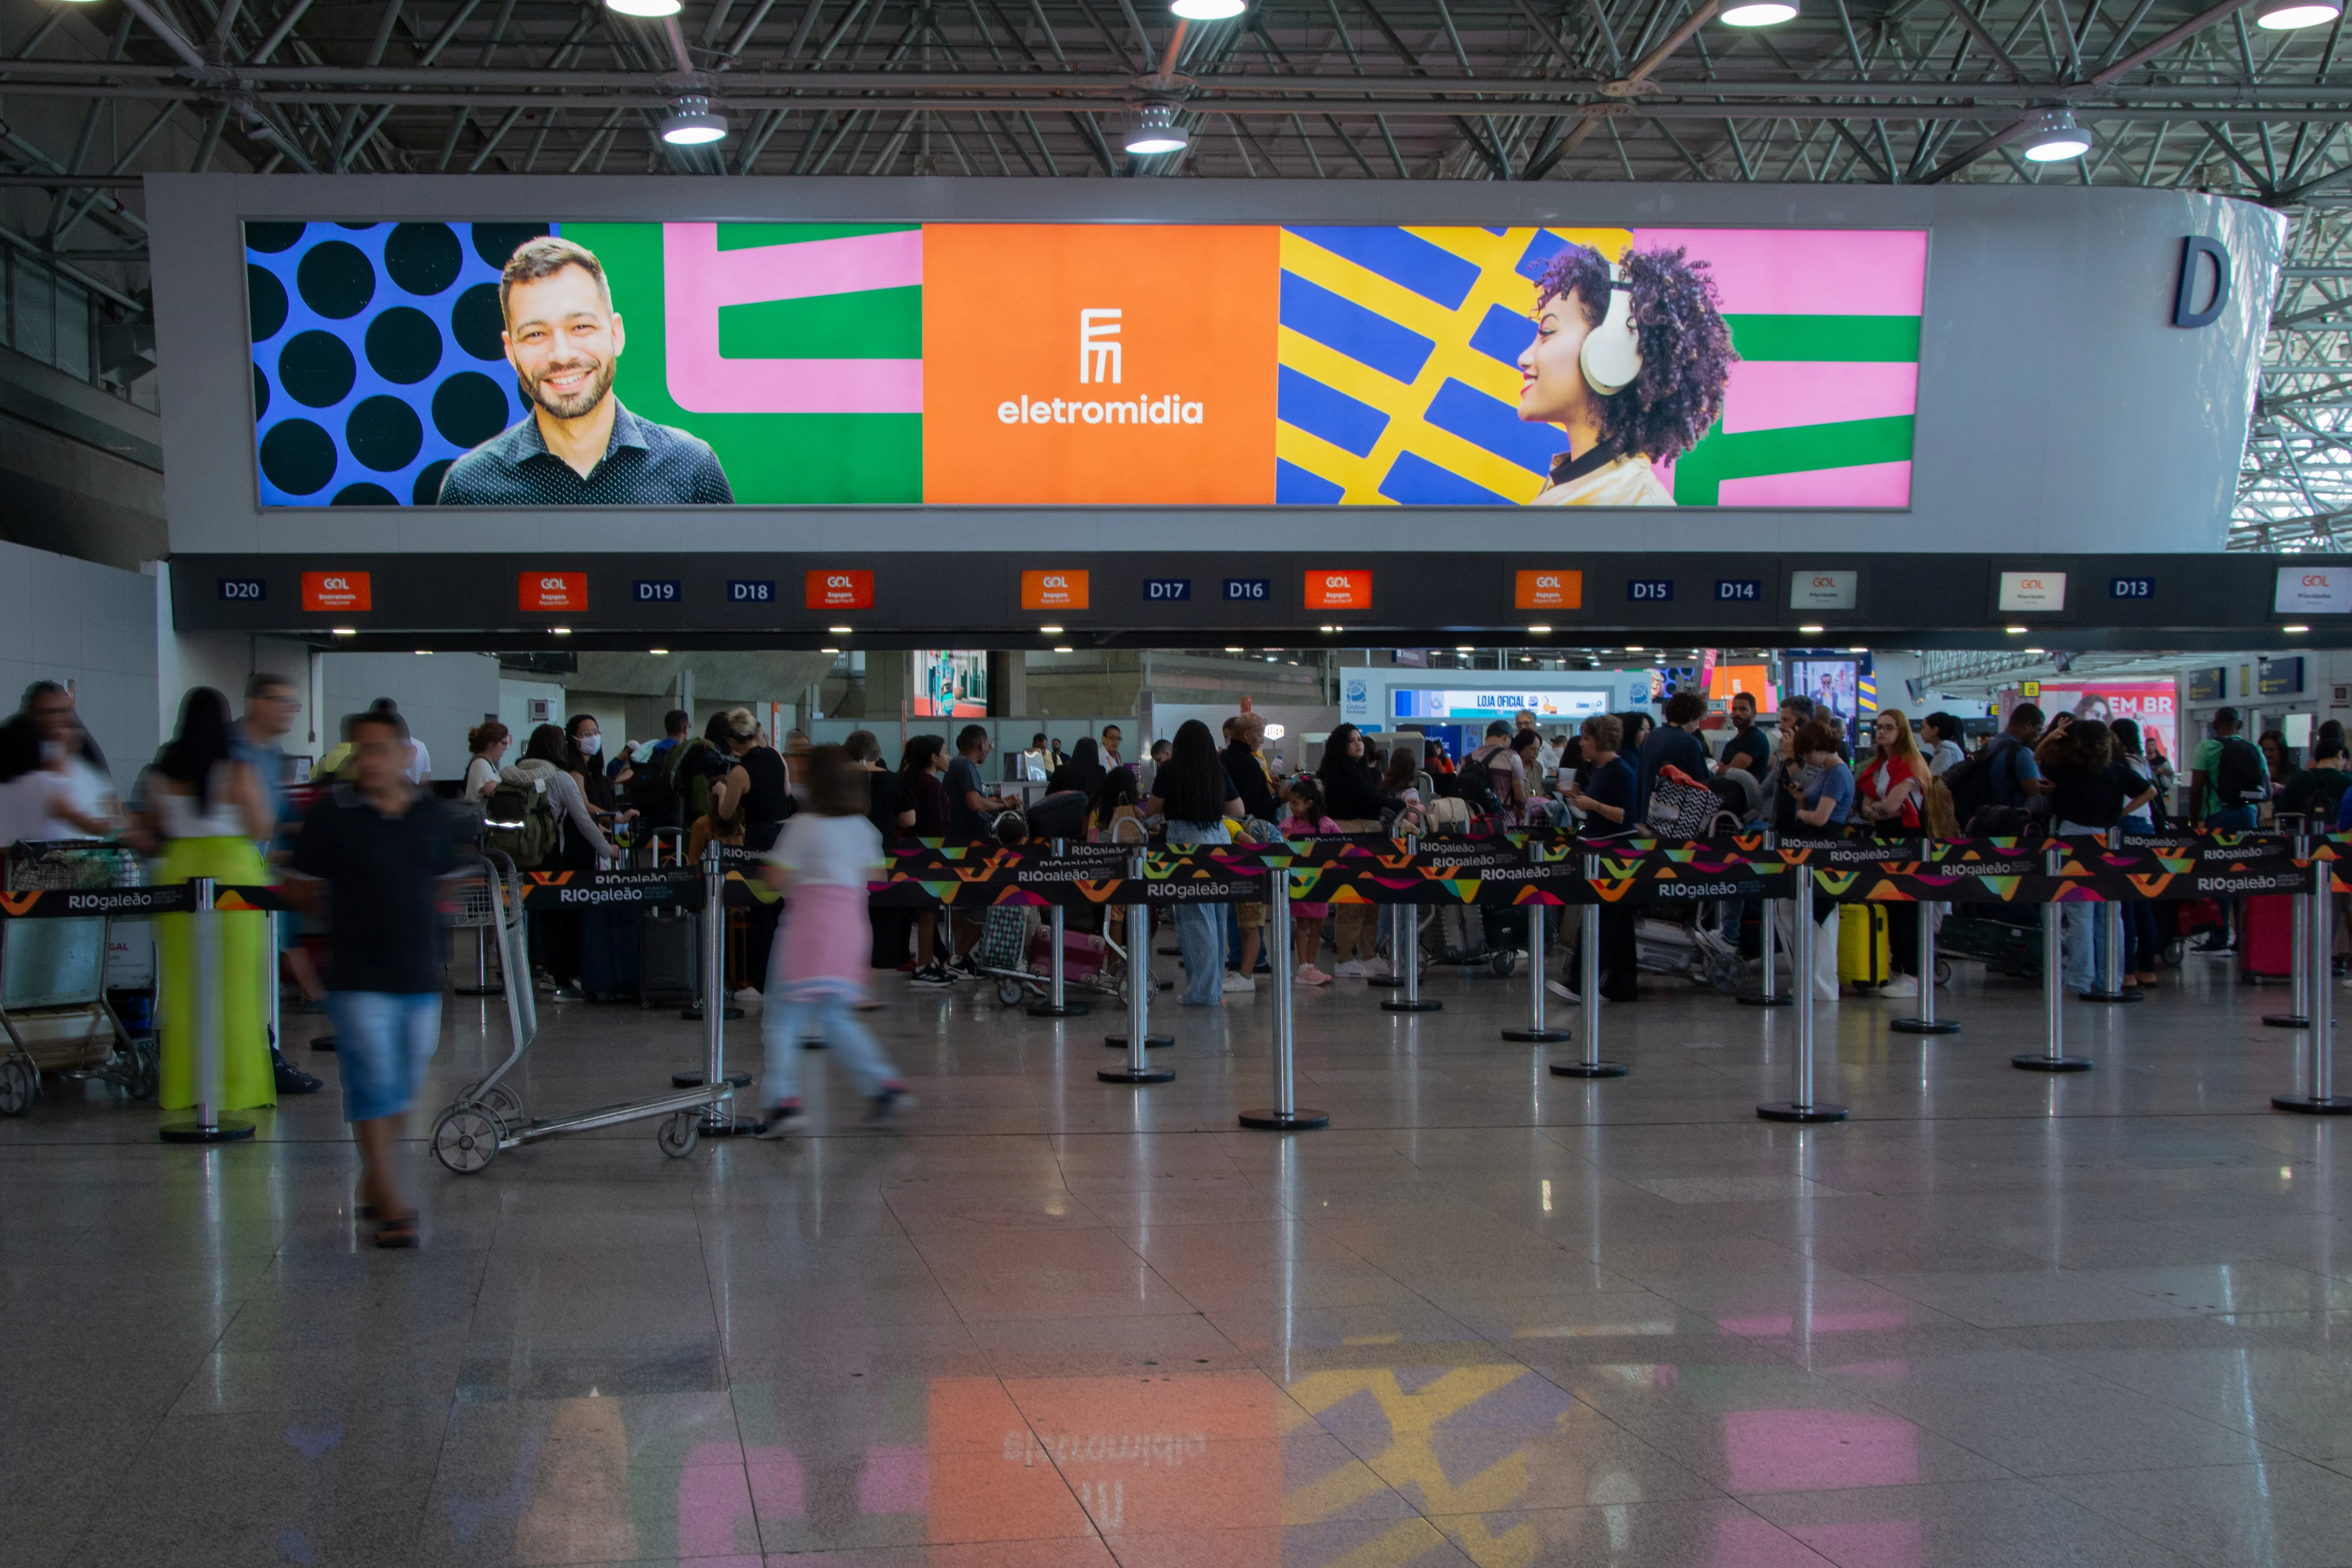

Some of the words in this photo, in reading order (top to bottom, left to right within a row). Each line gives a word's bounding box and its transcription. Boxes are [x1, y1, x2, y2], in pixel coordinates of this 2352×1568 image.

[2172, 235, 2231, 328] D
[997, 394, 1203, 424] eletromidia
[324, 578, 349, 589] GOL
[541, 578, 566, 589] GOL
[827, 576, 852, 588] GOL
[1043, 576, 1068, 588] GOL
[1326, 576, 1351, 588] GOL
[1536, 576, 1560, 588] GOL
[1813, 577, 1836, 588] GOL
[2021, 579, 2044, 589] GOL
[2302, 575, 2329, 587] GOL
[225, 583, 259, 598] D20
[640, 584, 673, 599] D19
[734, 584, 768, 599] D18
[1150, 583, 1183, 598] D17
[1230, 583, 1263, 598] D16
[1634, 583, 1666, 598] D15
[1721, 583, 1754, 598] D14
[2116, 581, 2148, 596] D13
[1477, 695, 1495, 707] LOJA
[1497, 695, 1525, 707] OFICIAL
[2108, 696, 2137, 713] EM
[2143, 696, 2172, 713] BR
[1420, 842, 1475, 854] RIOgaleão
[1781, 838, 1837, 849] RIOgaleão
[2124, 836, 2177, 849] RIOgaleão
[1830, 849, 1890, 863] RIOgaleão
[2204, 847, 2263, 860] RIOgaleão
[1432, 855, 1495, 867] RIOgaleão
[1018, 869, 1089, 882] RIOgaleão
[1481, 866, 1550, 881] RIOgaleão
[1941, 862, 2011, 876] RIOgaleão
[1147, 882, 1229, 899] RIOgaleão
[1658, 881, 1737, 899] RIOgaleão
[2198, 876, 2276, 893] RIOgaleão
[68, 892, 152, 911] RIOgaleão
[561, 887, 642, 905] RIOgaleão
